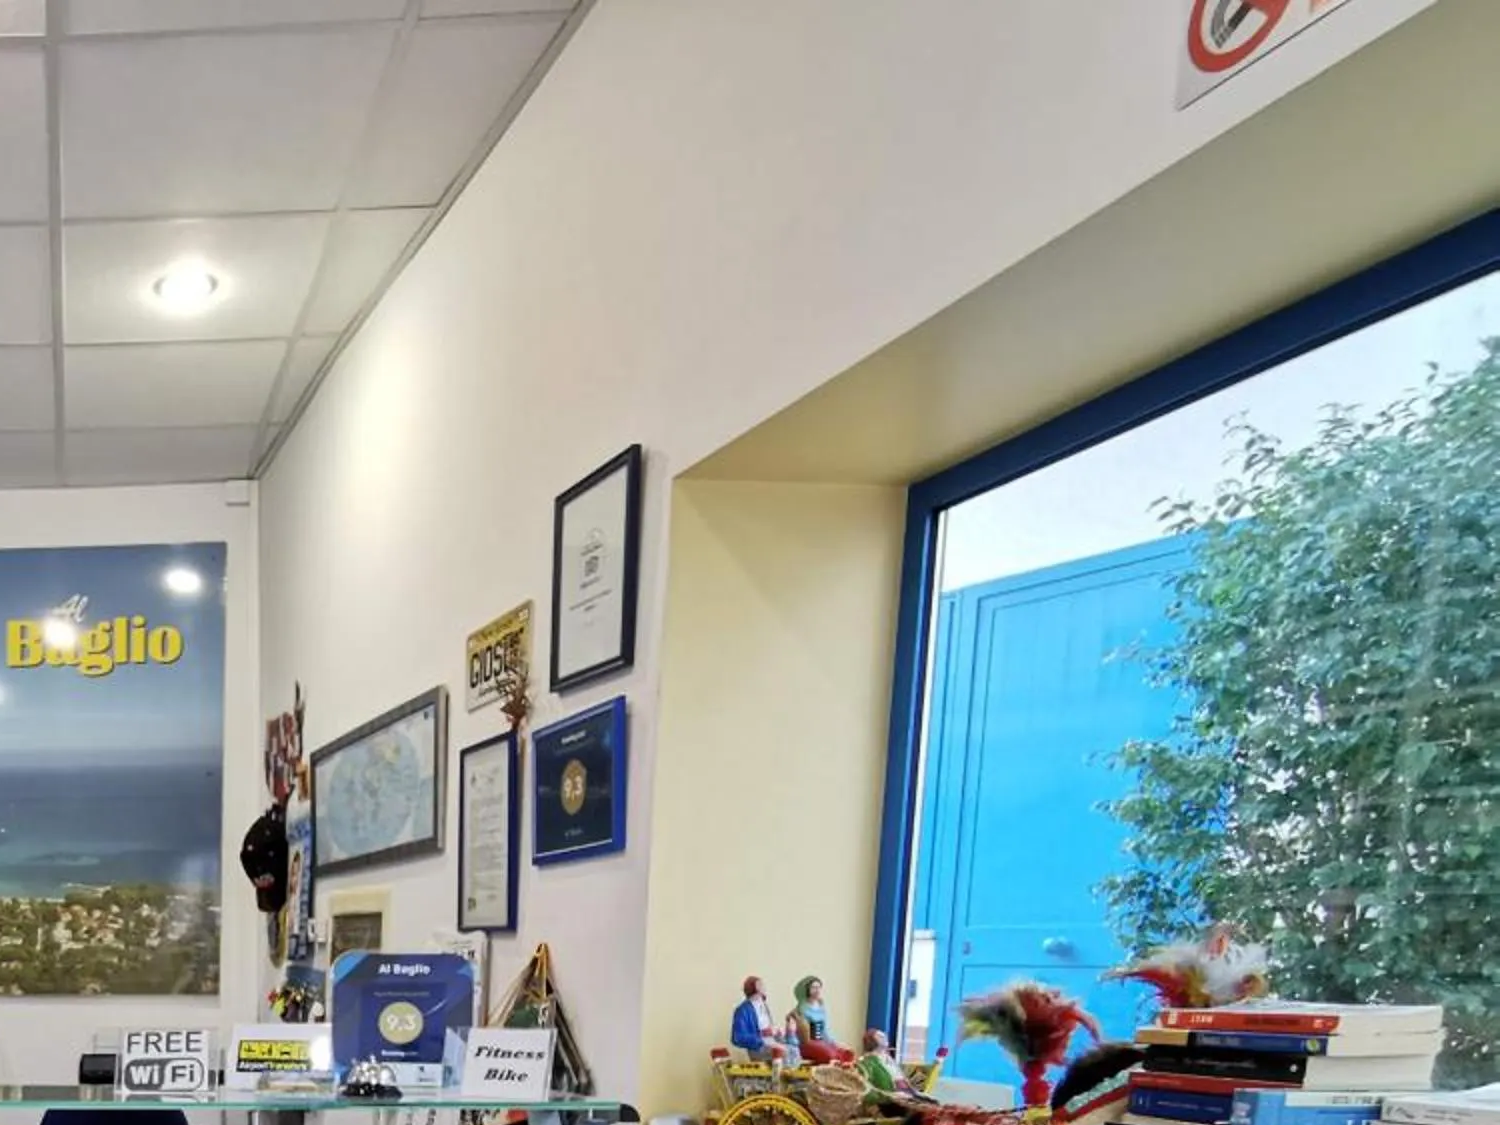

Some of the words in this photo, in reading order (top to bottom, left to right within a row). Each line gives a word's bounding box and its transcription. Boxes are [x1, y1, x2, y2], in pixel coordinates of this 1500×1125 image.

[126, 1030, 203, 1054] FREE
[474, 1045, 546, 1060] Fitness
[484, 1067, 529, 1083] Bike
